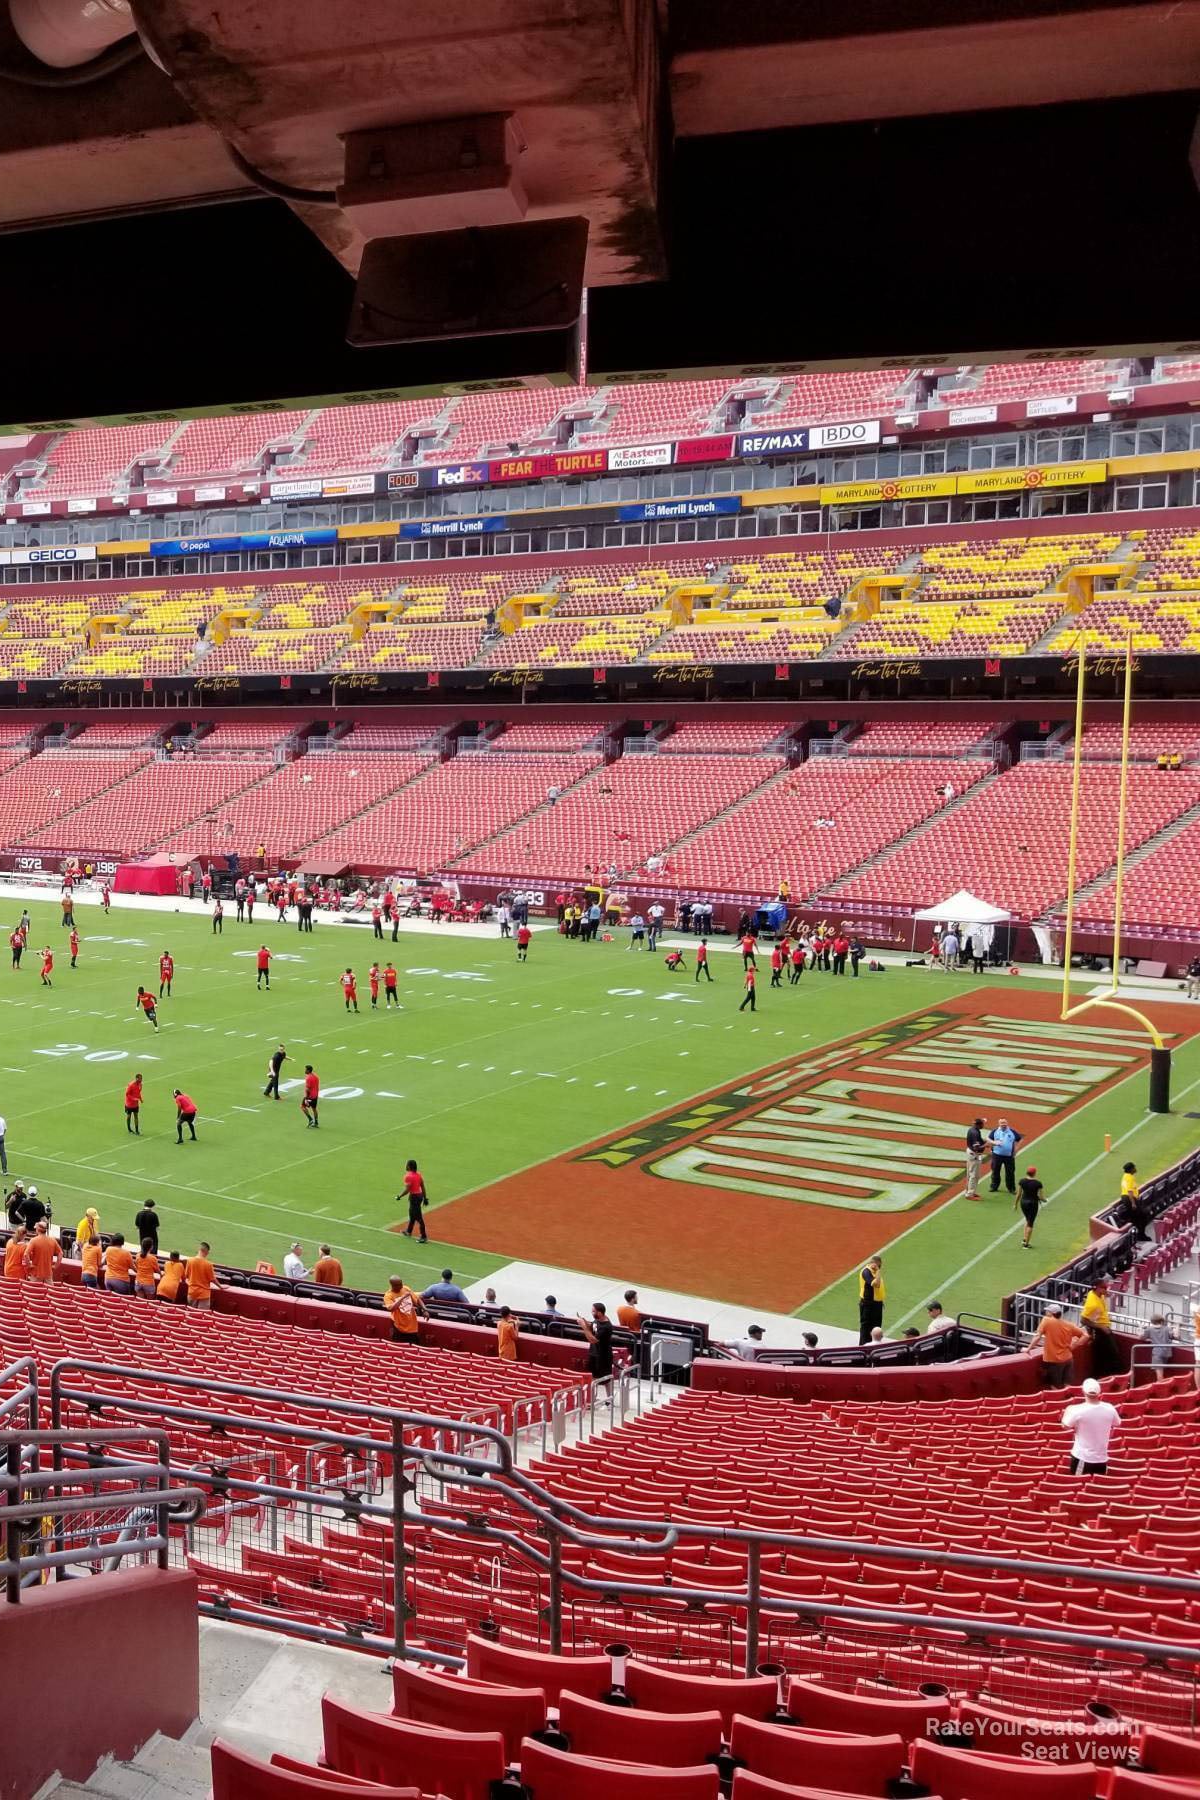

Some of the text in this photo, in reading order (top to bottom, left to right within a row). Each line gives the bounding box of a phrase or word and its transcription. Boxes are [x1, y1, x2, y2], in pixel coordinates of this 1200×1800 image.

[826, 424, 866, 442] BDO
[742, 433, 803, 453] RE/MAX
[622, 447, 667, 460] Eastern
[437, 466, 482, 485] FedEx
[975, 475, 1023, 487] MARYLAND
[1044, 470, 1085, 482] LOTTERY
[836, 488, 880, 499] MARYLAND
[900, 484, 937, 495] LOTTERY
[657, 502, 715, 516] Merrill Lynch
[431, 521, 483, 533] Merrill Lynch
[189, 541, 210, 551] pepsi
[28, 548, 77, 562] GEICO
